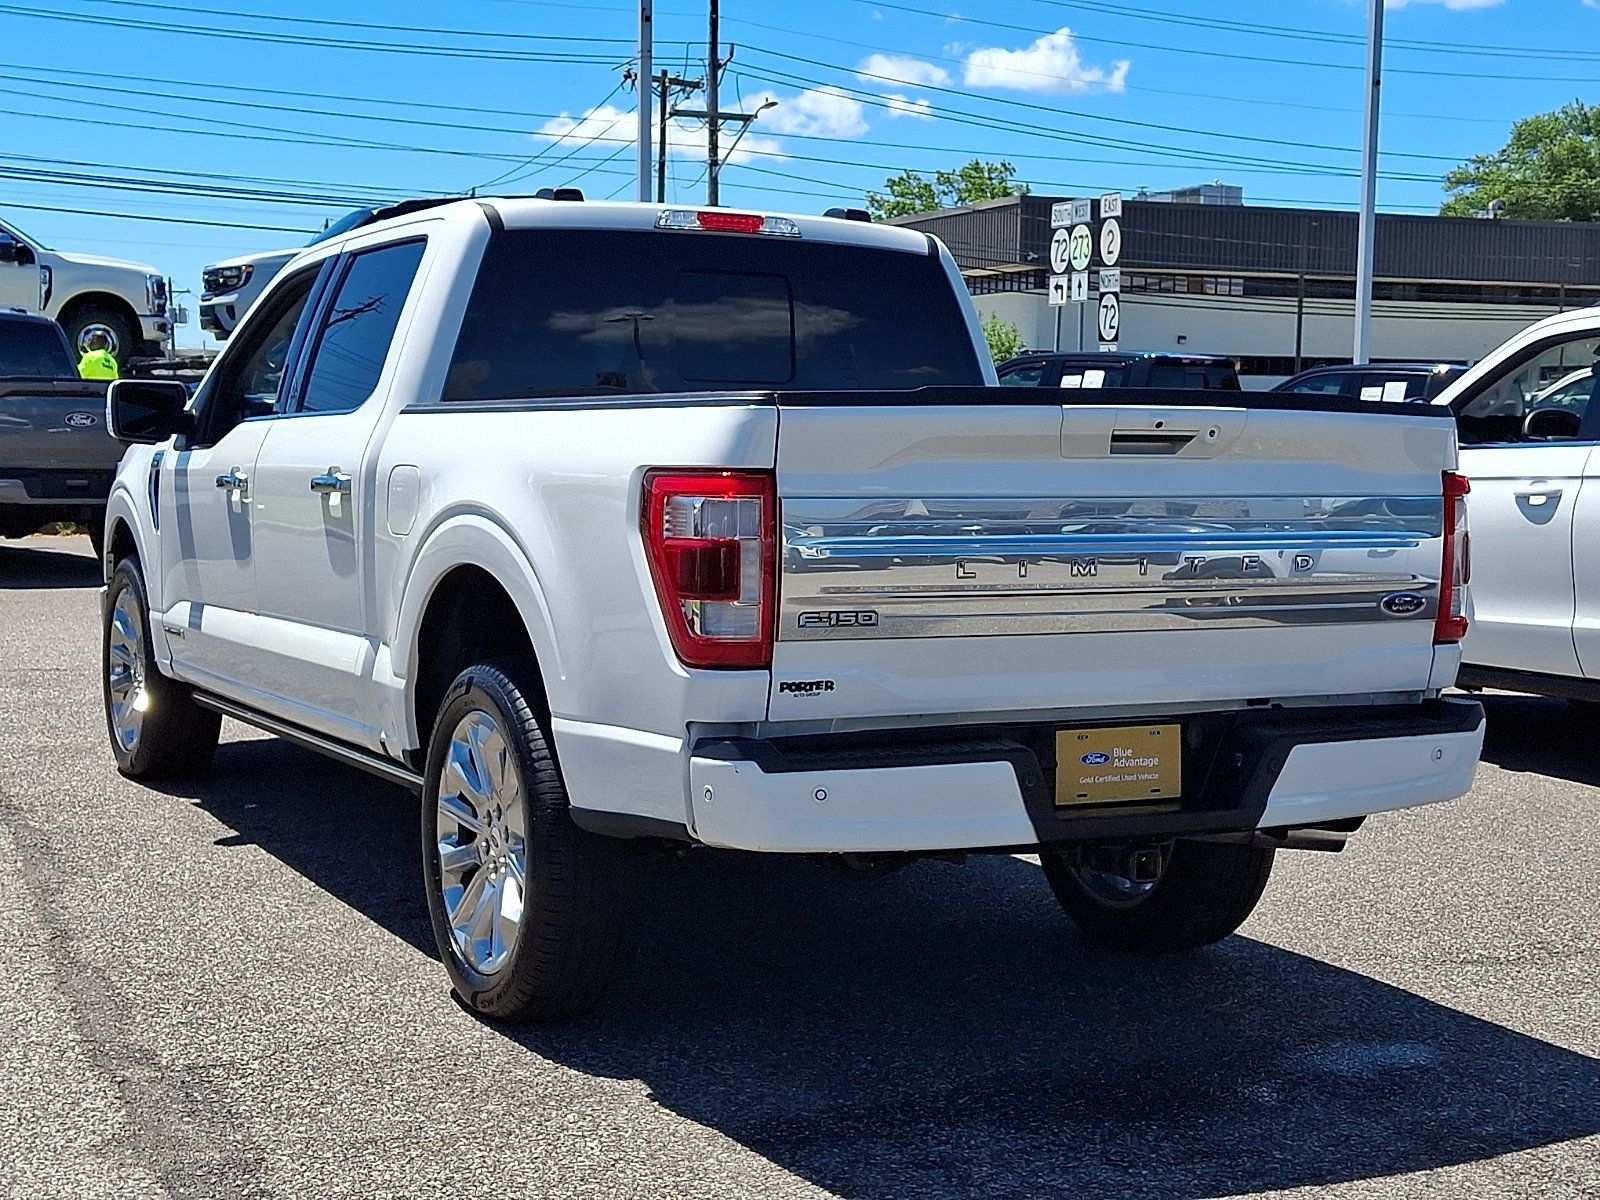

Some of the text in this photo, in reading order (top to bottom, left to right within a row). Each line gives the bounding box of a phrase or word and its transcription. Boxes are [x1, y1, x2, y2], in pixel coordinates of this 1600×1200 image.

[1074, 203, 1089, 218] WEST
[1104, 198, 1118, 213] EAST
[1053, 207, 1071, 223] SOUTH
[1072, 233, 1090, 261] 273
[1106, 229, 1115, 255] 2
[1054, 239, 1067, 264] 72
[1100, 273, 1119, 289] NORTH
[1102, 305, 1116, 331] 72
[955, 554, 1316, 579] LIMITED
[798, 610, 879, 628] F-150
[779, 680, 835, 693] PORTER
[1113, 747, 1133, 757] Blue
[1113, 757, 1159, 768] Advantage
[1079, 772, 1159, 784] Gold Certified Used Vehicle
